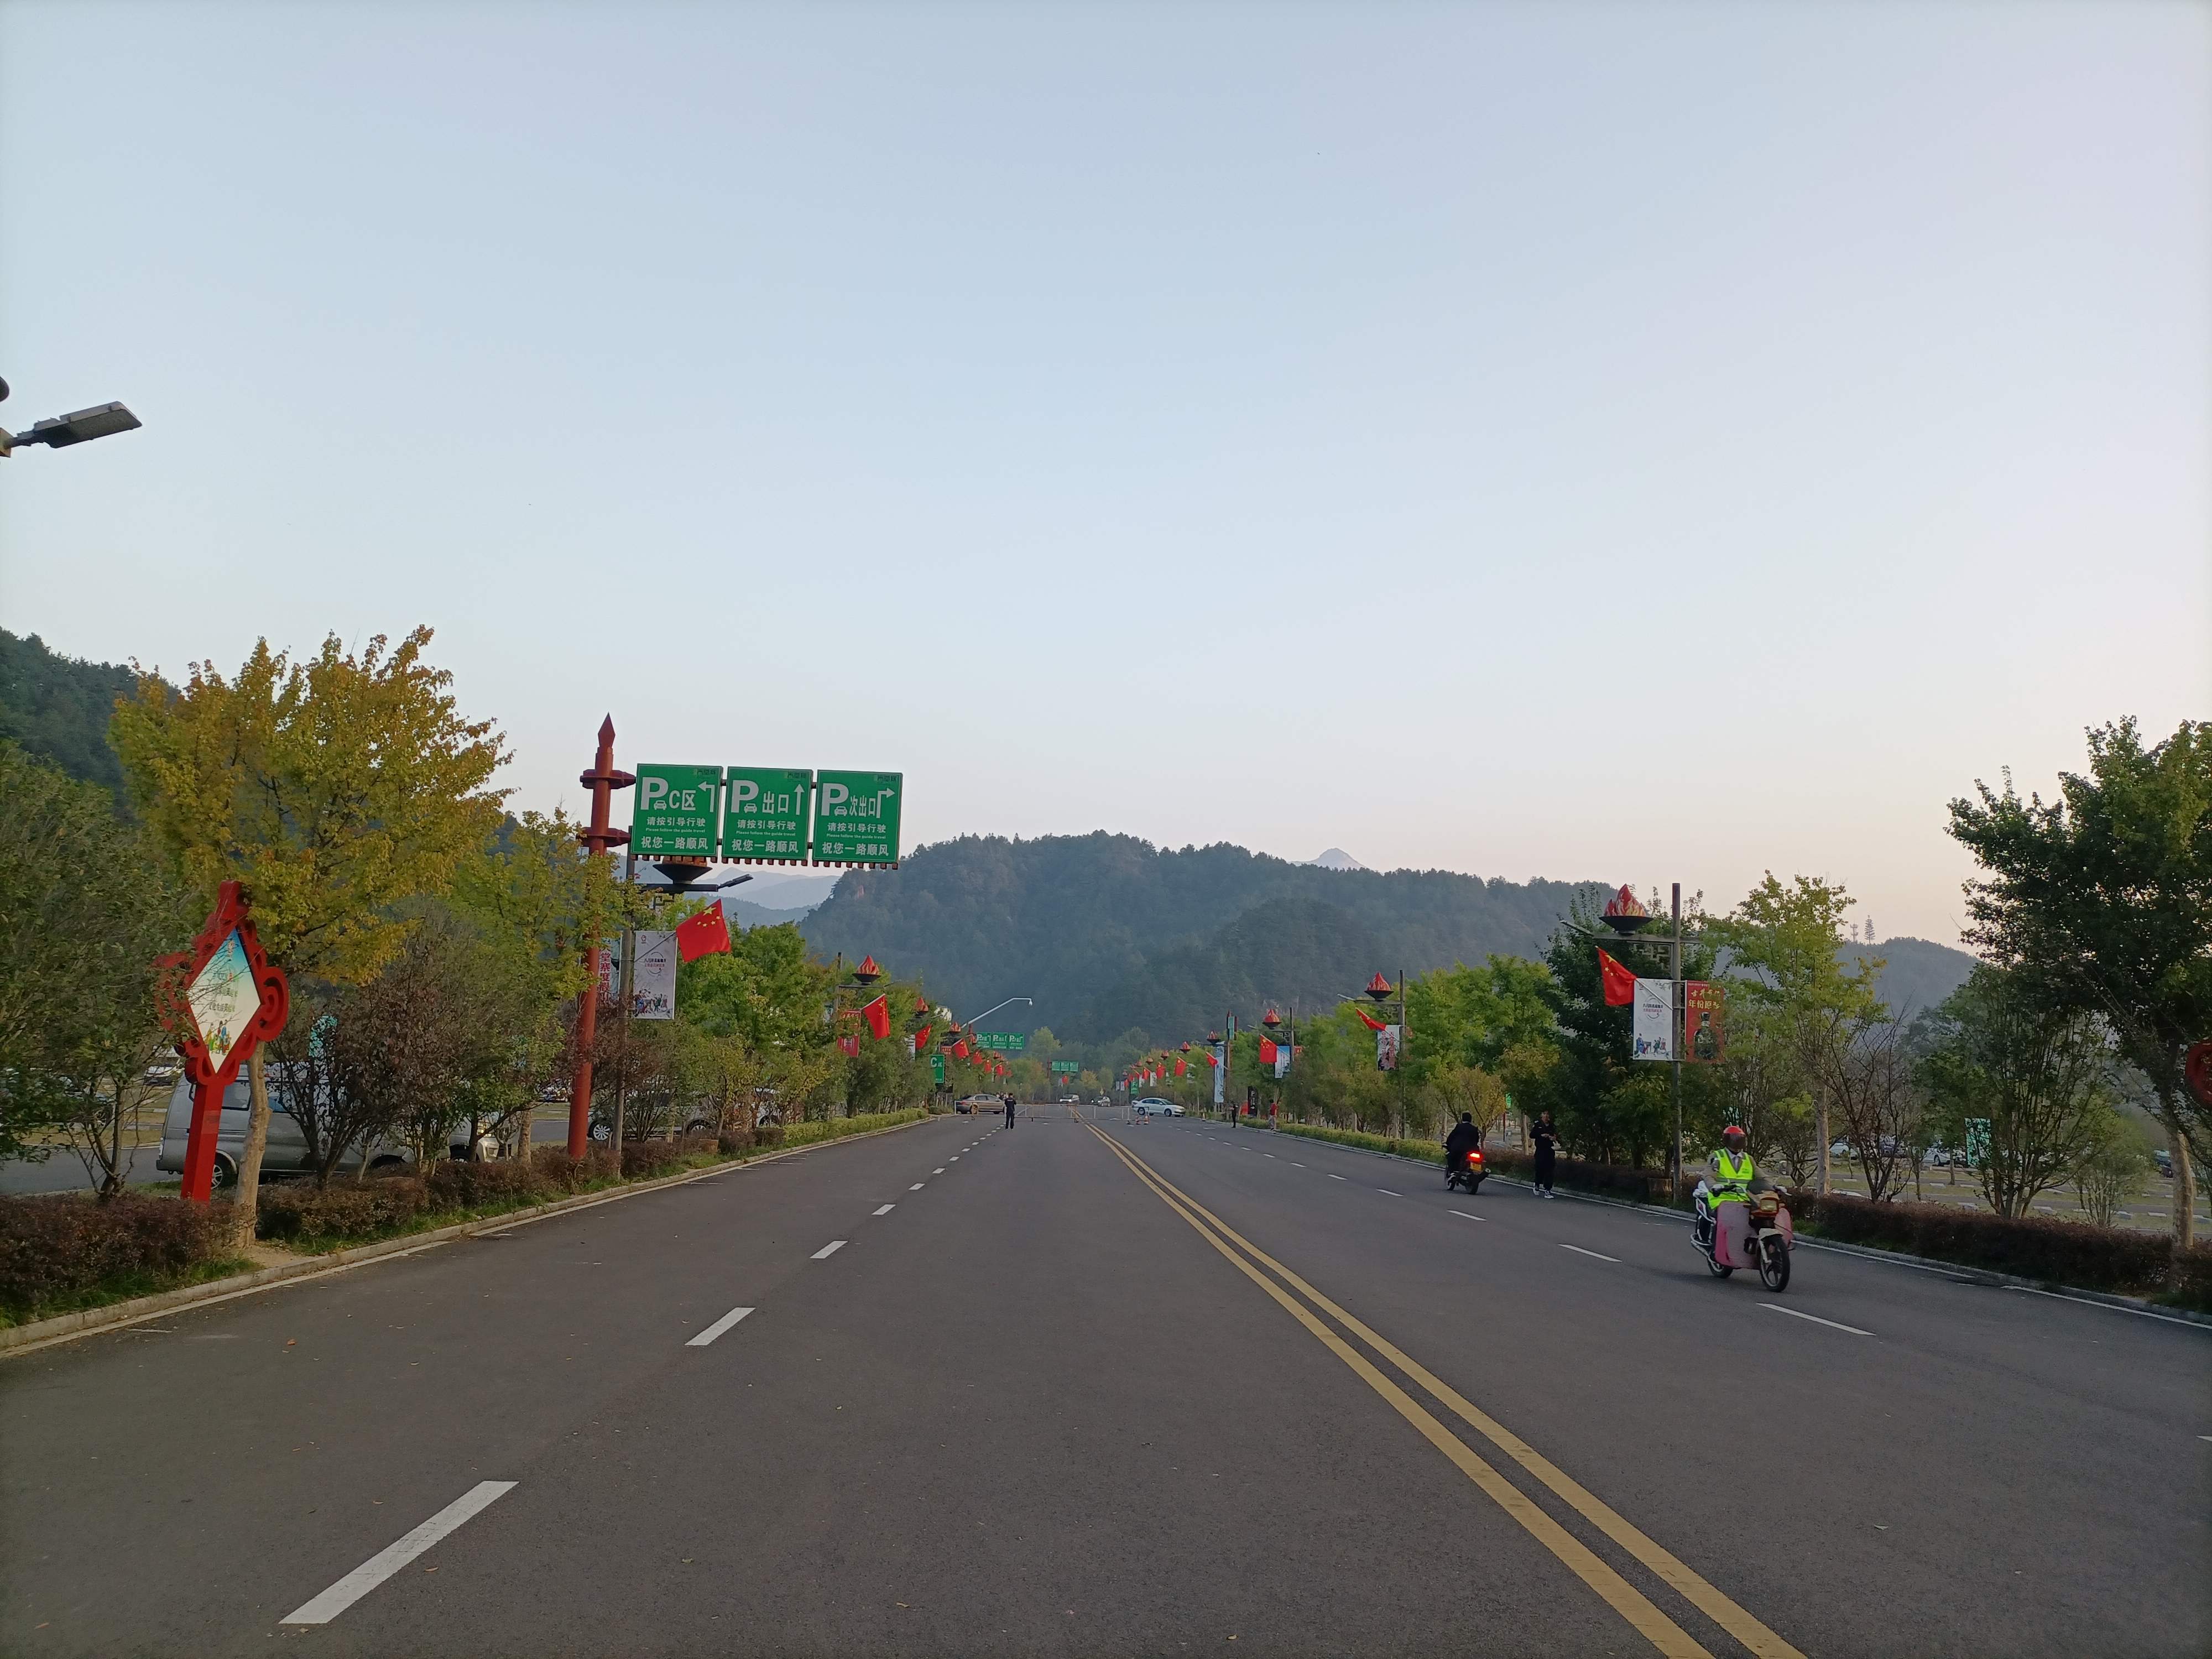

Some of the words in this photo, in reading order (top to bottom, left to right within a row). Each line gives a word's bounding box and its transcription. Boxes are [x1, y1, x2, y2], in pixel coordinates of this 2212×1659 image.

[640, 776, 669, 810] P
[669, 790, 696, 811] C区
[731, 780, 759, 813] P
[762, 791, 789, 814] 出口
[821, 782, 849, 816] P
[849, 795, 876, 817] 次出口
[646, 816, 706, 827] 请按引导行驶
[737, 819, 796, 830] 请按引导行驶
[827, 822, 886, 833] 请按引导行驶
[641, 836, 708, 850] 祝您一路顺风
[732, 838, 799, 853] 祝您一路顺风
[822, 842, 889, 857] 祝您一路顺风
